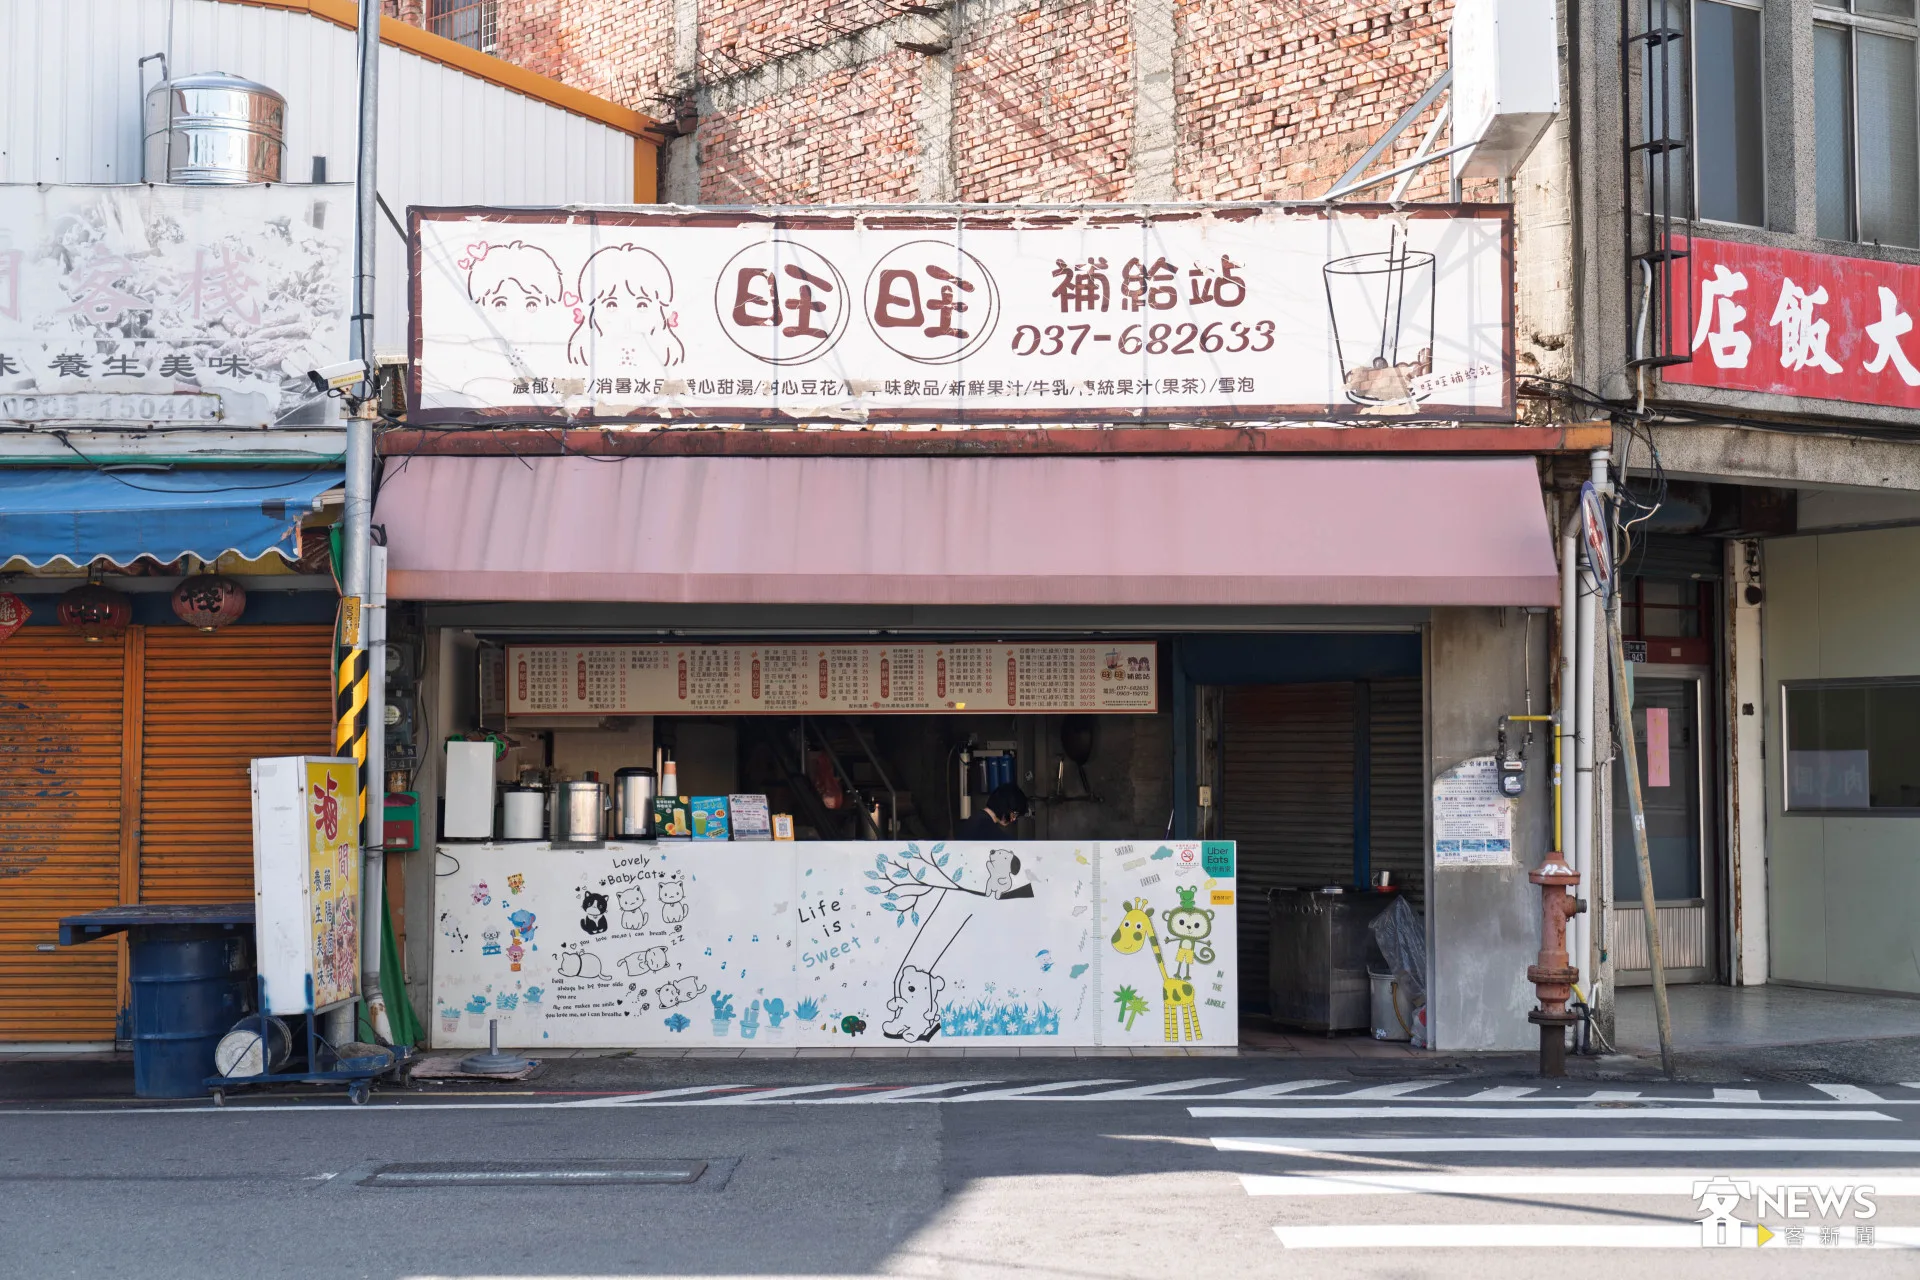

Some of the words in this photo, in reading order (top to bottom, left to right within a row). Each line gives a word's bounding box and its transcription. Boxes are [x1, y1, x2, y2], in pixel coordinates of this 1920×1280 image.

[1050, 254, 1248, 313] 補給站
[1010, 319, 1277, 357] 037-682633
[612, 854, 650, 868] Lovely
[798, 899, 841, 923] Life
[822, 921, 841, 938] is
[802, 936, 861, 968] Sweet
